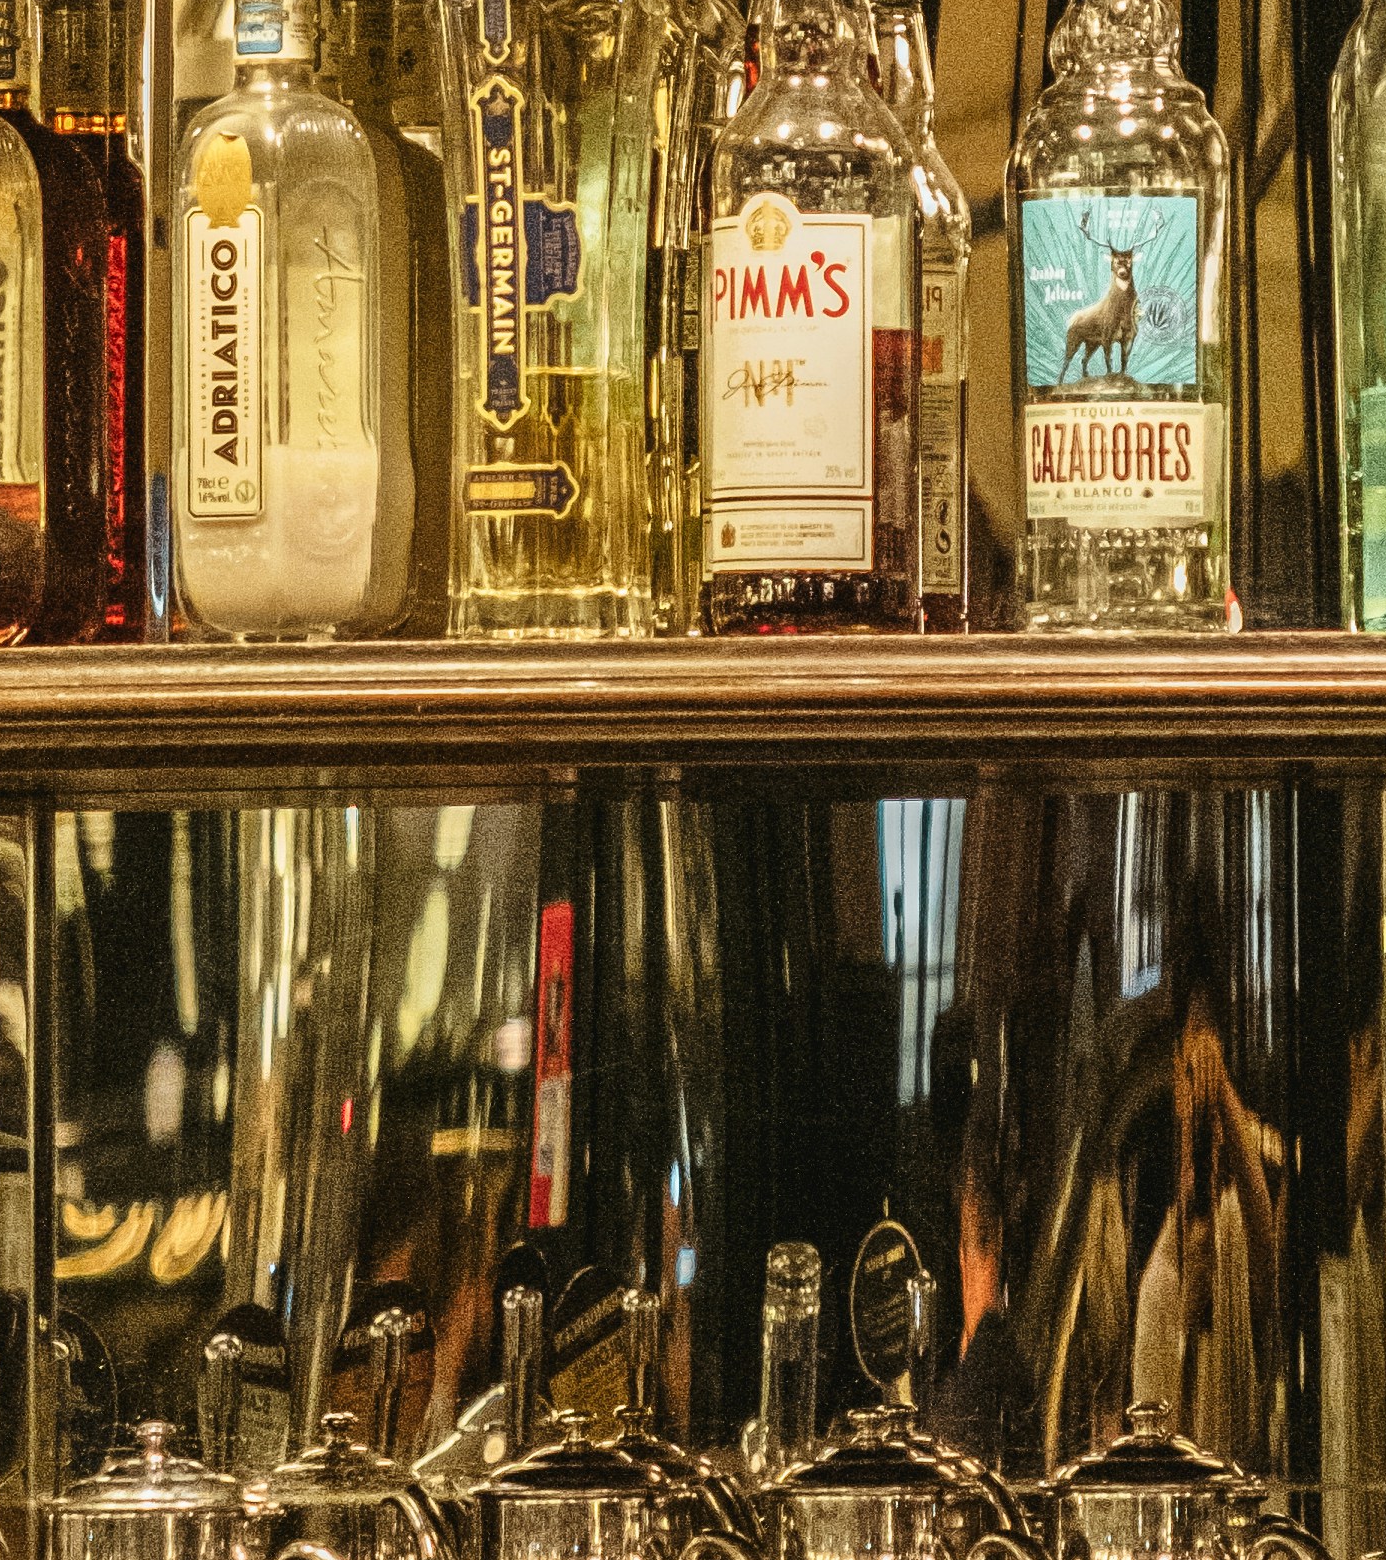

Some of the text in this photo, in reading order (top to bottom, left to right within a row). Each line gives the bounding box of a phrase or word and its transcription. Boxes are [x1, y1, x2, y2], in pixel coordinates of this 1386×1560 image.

[488, 147, 515, 355] ST-GERMAIN
[715, 250, 850, 321] PIMM'S
[211, 239, 239, 467] ADRIATICO
[1072, 407, 1135, 420] TEQUILA
[1031, 422, 1191, 483] CAZADORES
[1074, 487, 1132, 498] BLANCO
